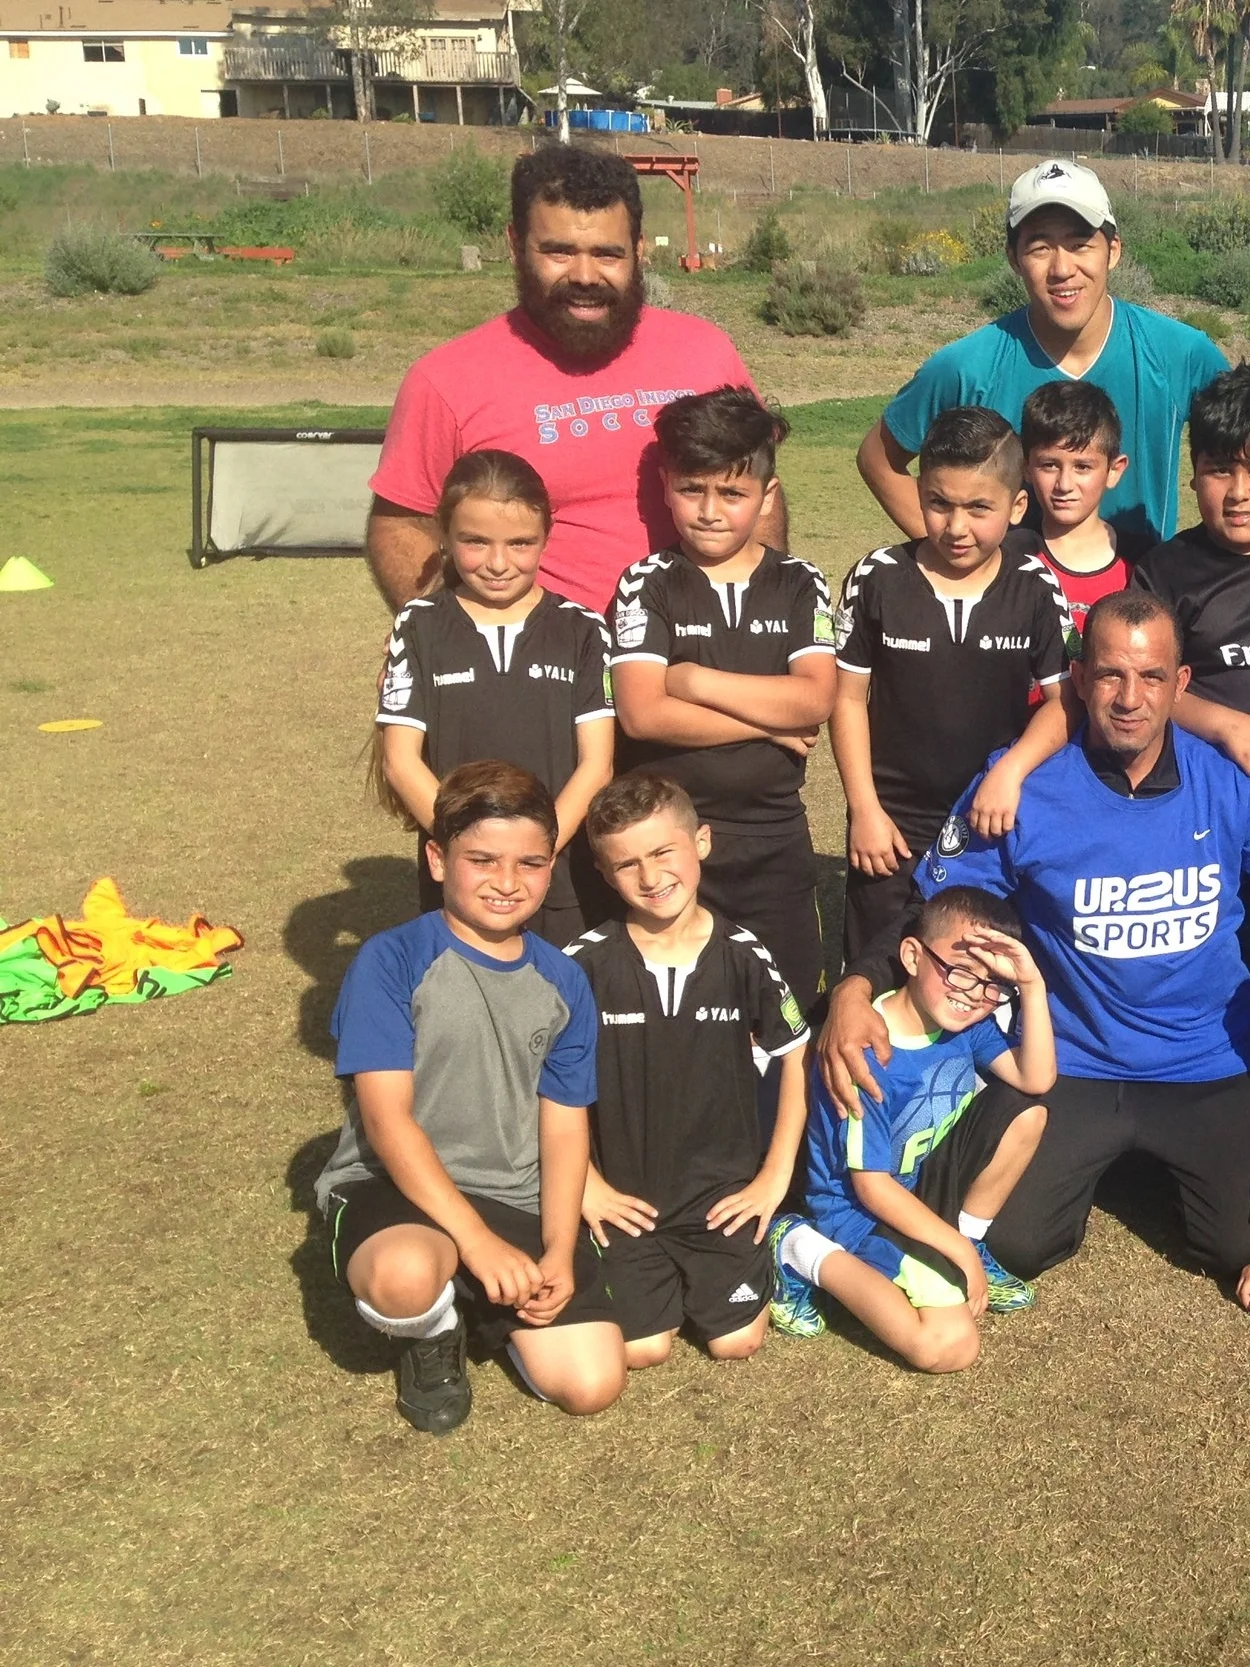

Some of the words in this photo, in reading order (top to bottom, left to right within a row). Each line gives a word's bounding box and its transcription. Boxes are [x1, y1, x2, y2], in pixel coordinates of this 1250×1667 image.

[539, 408, 652, 444] SOCC
[765, 619, 789, 633] YAL
[882, 632, 931, 652] hummel
[995, 636, 1031, 650] YALLA
[1081, 911, 1210, 950] SPORTS
[601, 1011, 646, 1026] humme
